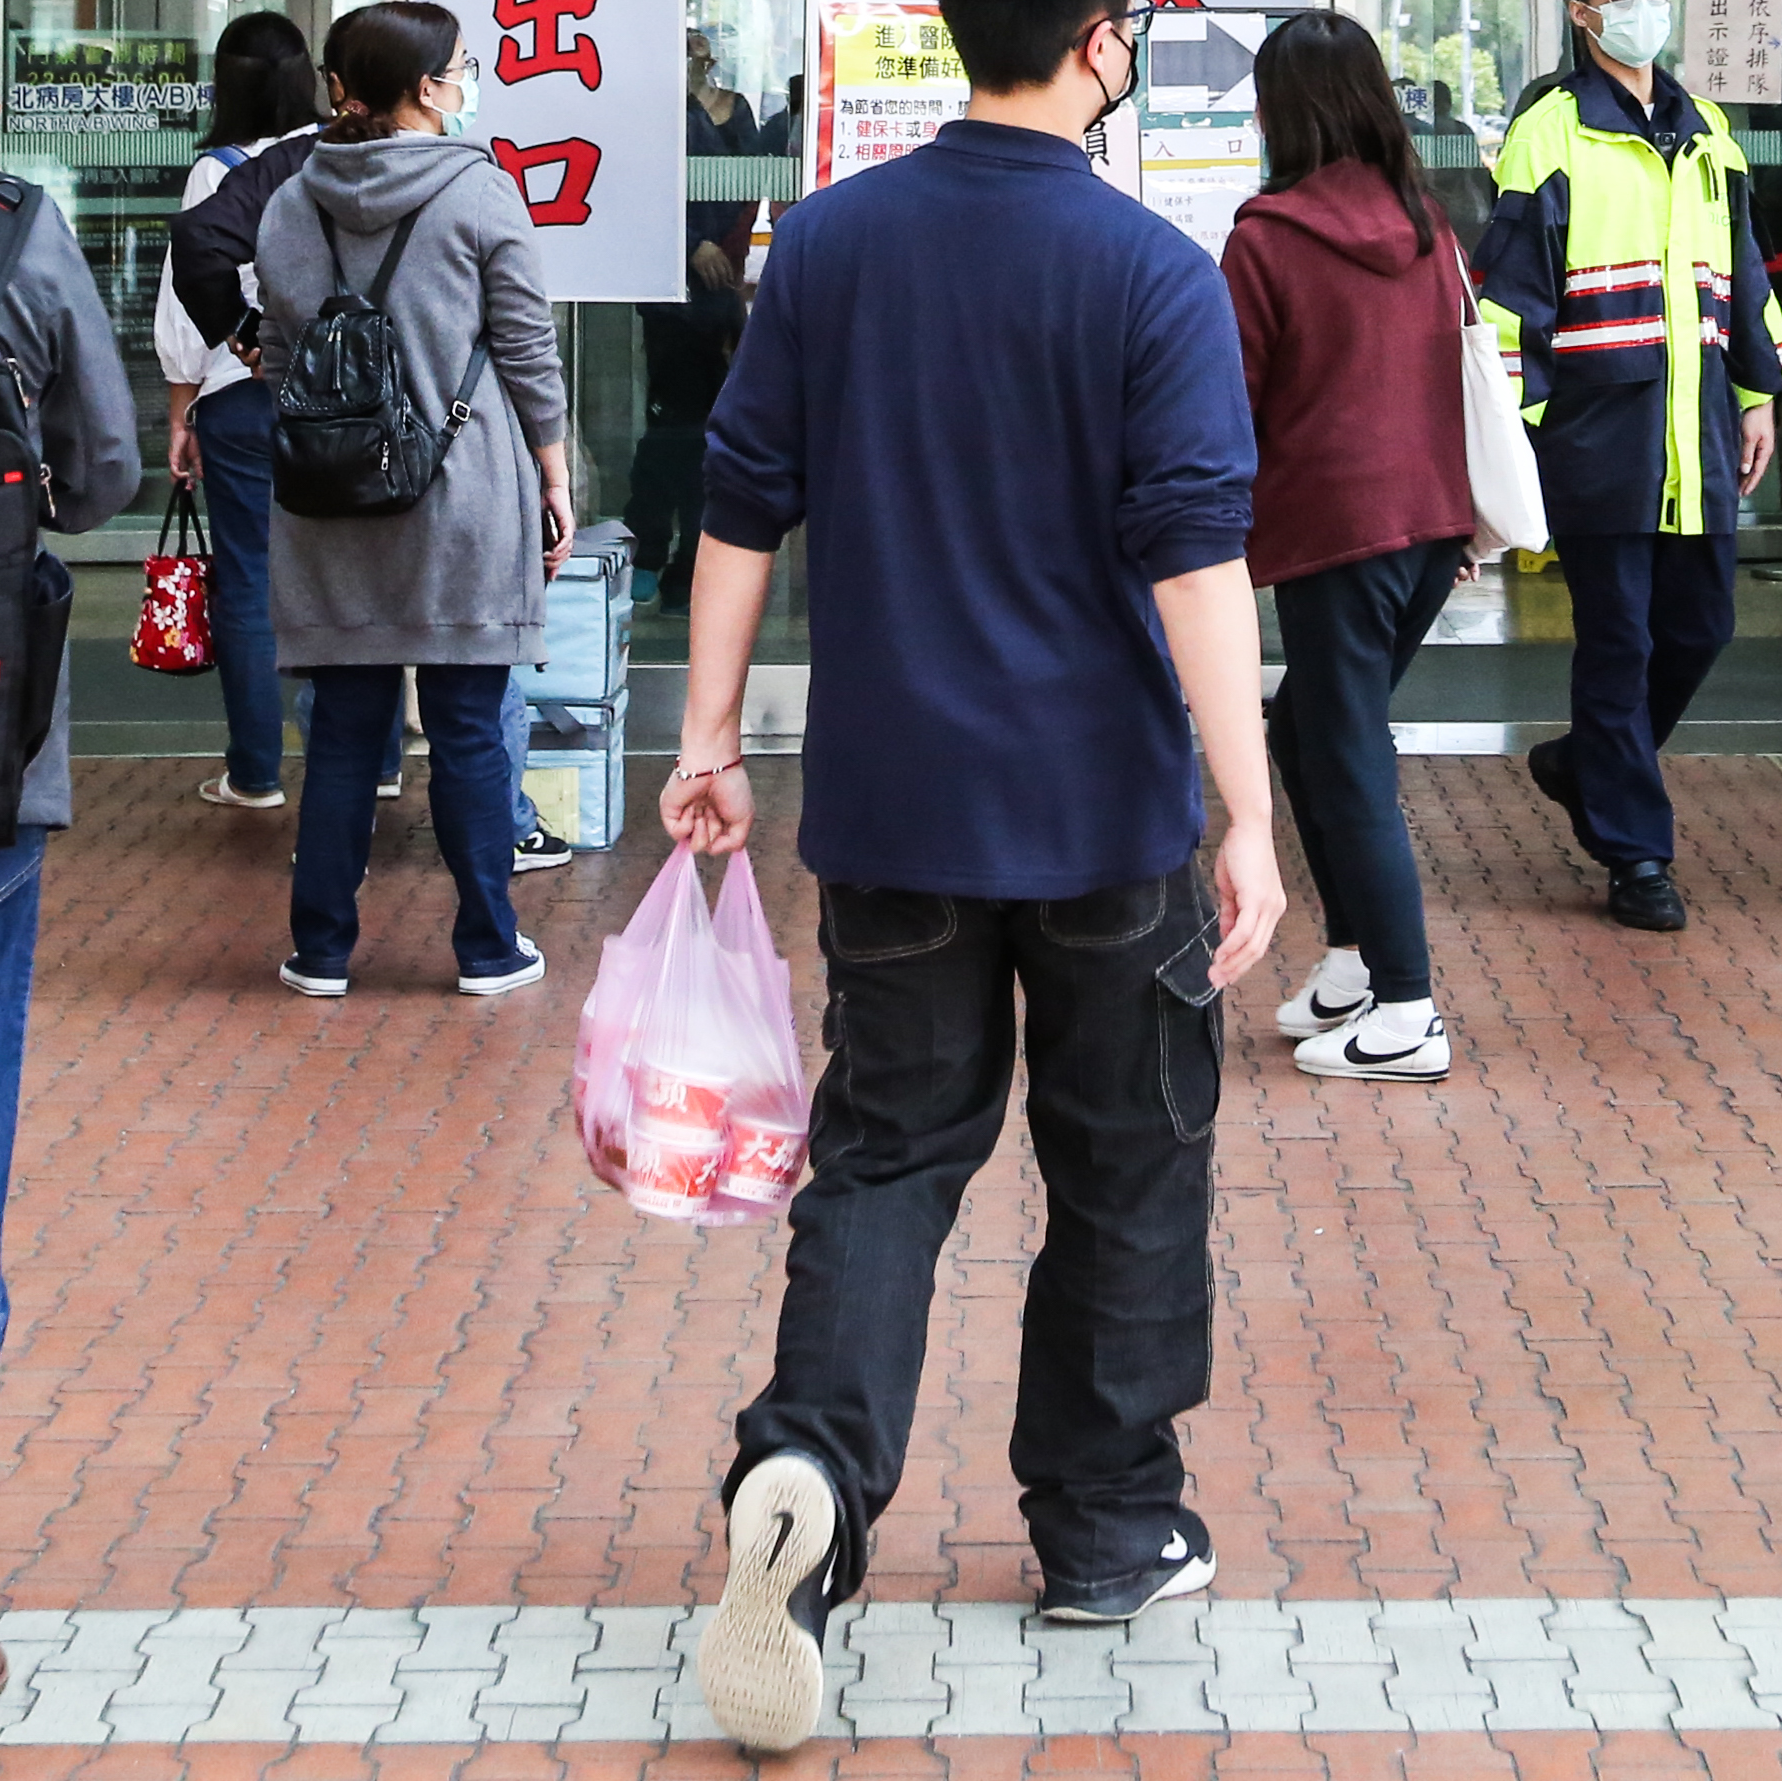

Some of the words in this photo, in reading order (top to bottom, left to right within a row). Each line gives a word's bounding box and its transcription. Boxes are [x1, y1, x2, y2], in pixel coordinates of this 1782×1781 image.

[875, 56, 968, 80] 您準備好
[856, 122, 941, 138] 健保卡或身
